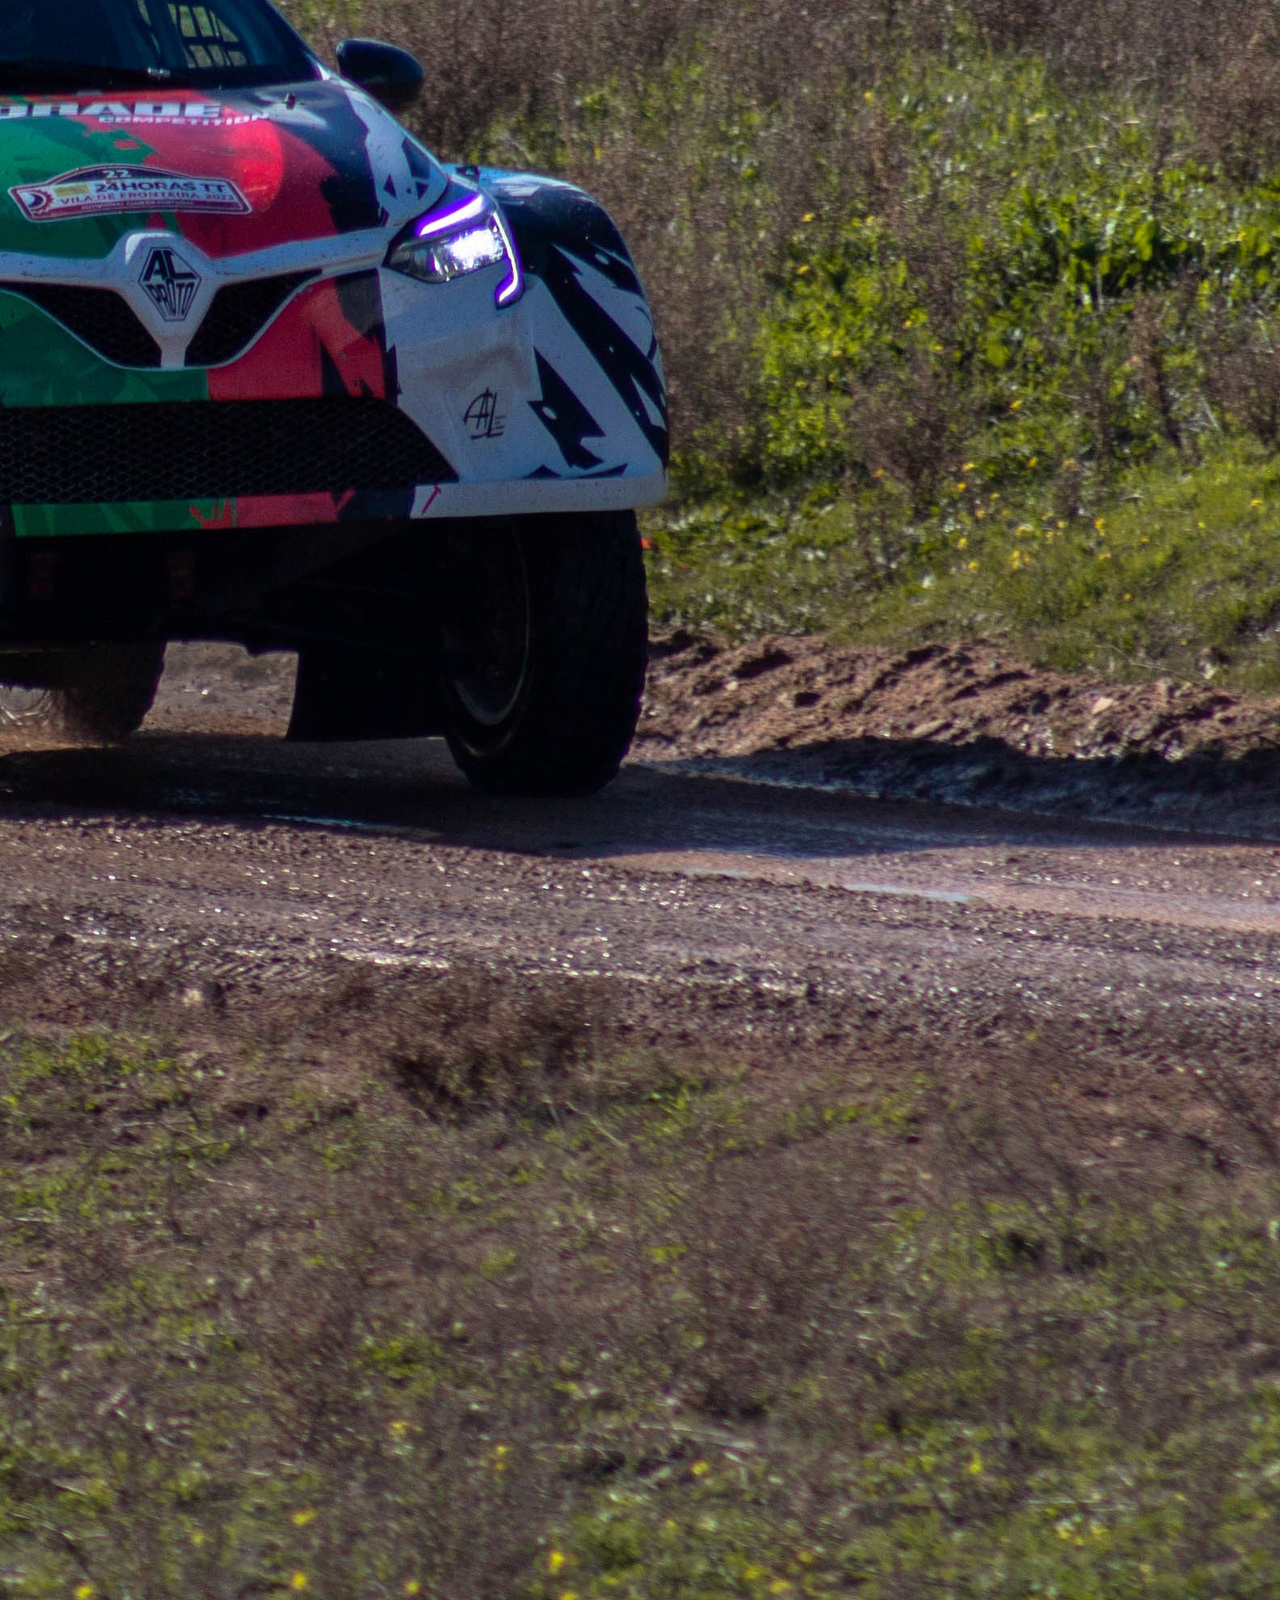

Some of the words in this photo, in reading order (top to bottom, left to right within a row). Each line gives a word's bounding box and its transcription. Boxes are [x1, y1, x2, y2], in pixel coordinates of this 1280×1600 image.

[102, 169, 132, 179] 22
[199, 182, 227, 193] TT
[60, 195, 94, 205] VILA
[119, 190, 200, 200] FRONTEIRA
[142, 250, 198, 281] AL
[145, 280, 196, 317] PROTO
